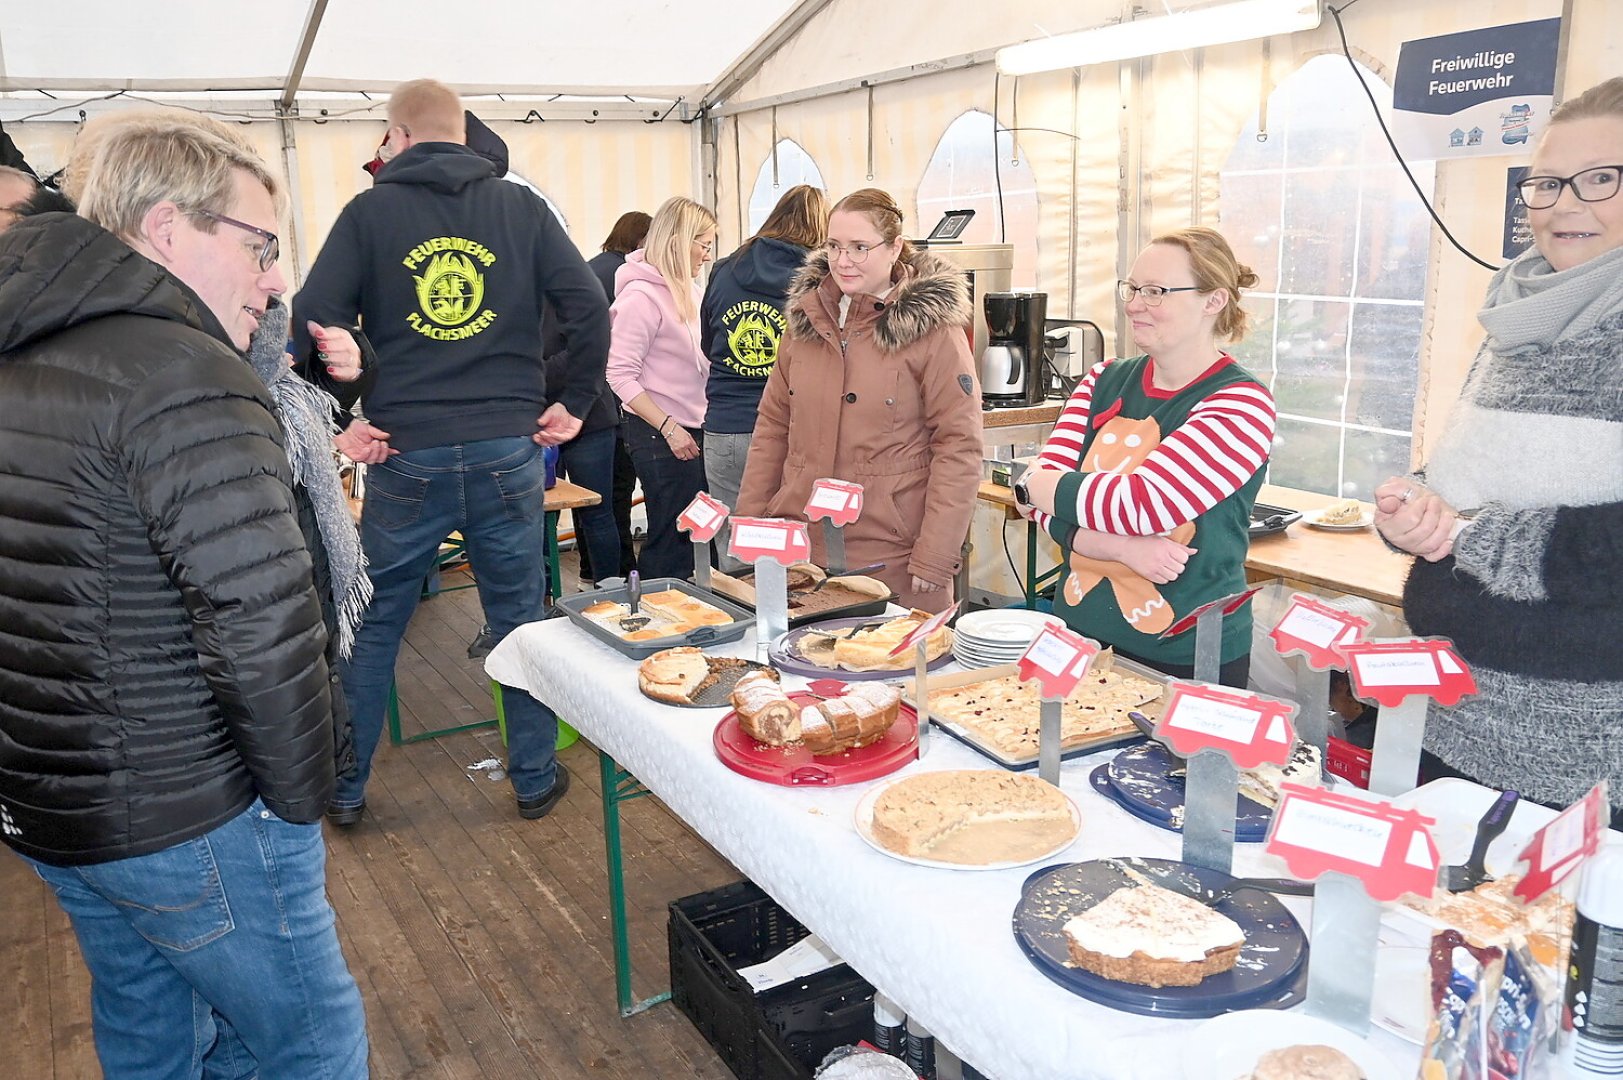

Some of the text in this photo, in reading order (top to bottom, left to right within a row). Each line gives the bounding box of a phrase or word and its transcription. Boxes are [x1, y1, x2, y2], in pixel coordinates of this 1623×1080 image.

[1431, 50, 1515, 74] Freiwillige
[1428, 72, 1514, 95] Feuerwehr
[402, 236, 497, 271] FEUERWEHR
[406, 309, 498, 341] FLACHSMEER
[721, 300, 787, 335] FEUERWEH
